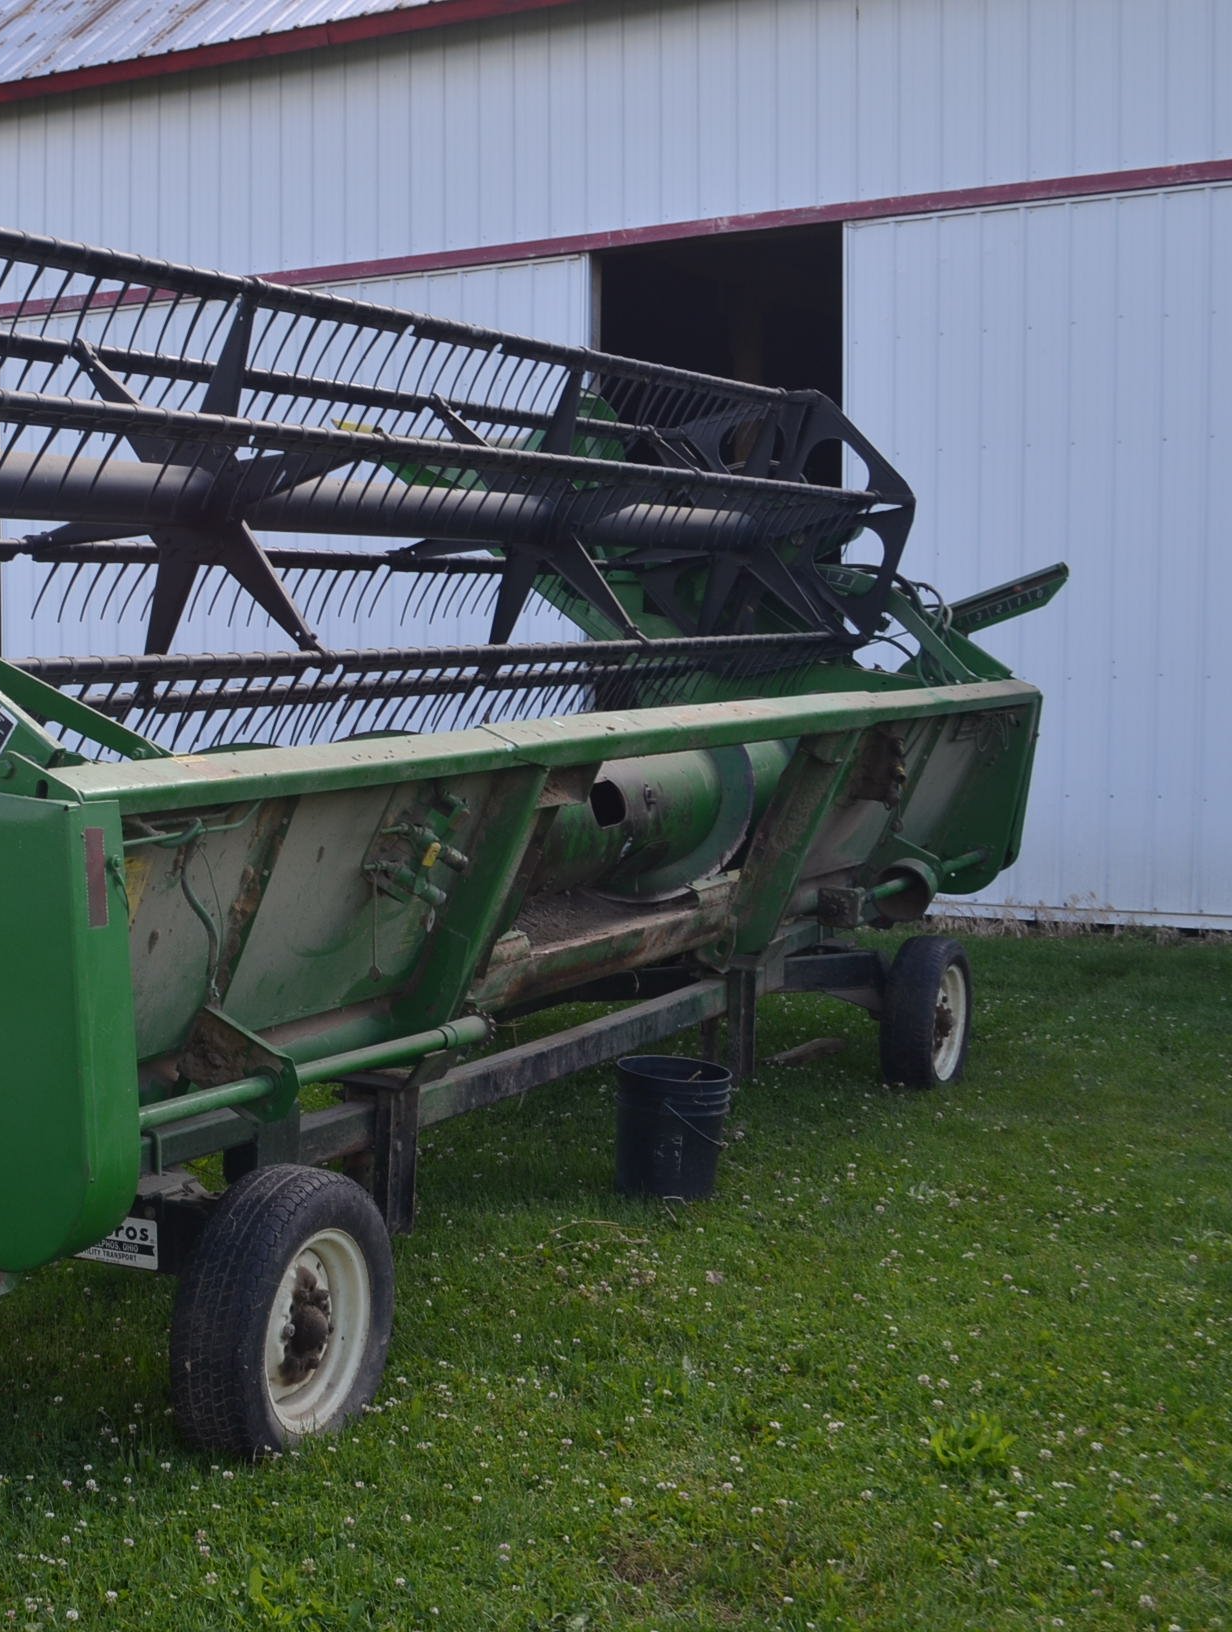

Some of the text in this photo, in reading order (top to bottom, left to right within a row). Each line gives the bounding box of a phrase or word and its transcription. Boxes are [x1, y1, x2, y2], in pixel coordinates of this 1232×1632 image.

[995, 604, 1003, 614] 2
[1036, 589, 1044, 599] 0
[113, 1225, 149, 1242] ros
[95, 1239, 139, 1253] LPHOS, OHIO
[103, 1250, 137, 1262] TRANSPORT
